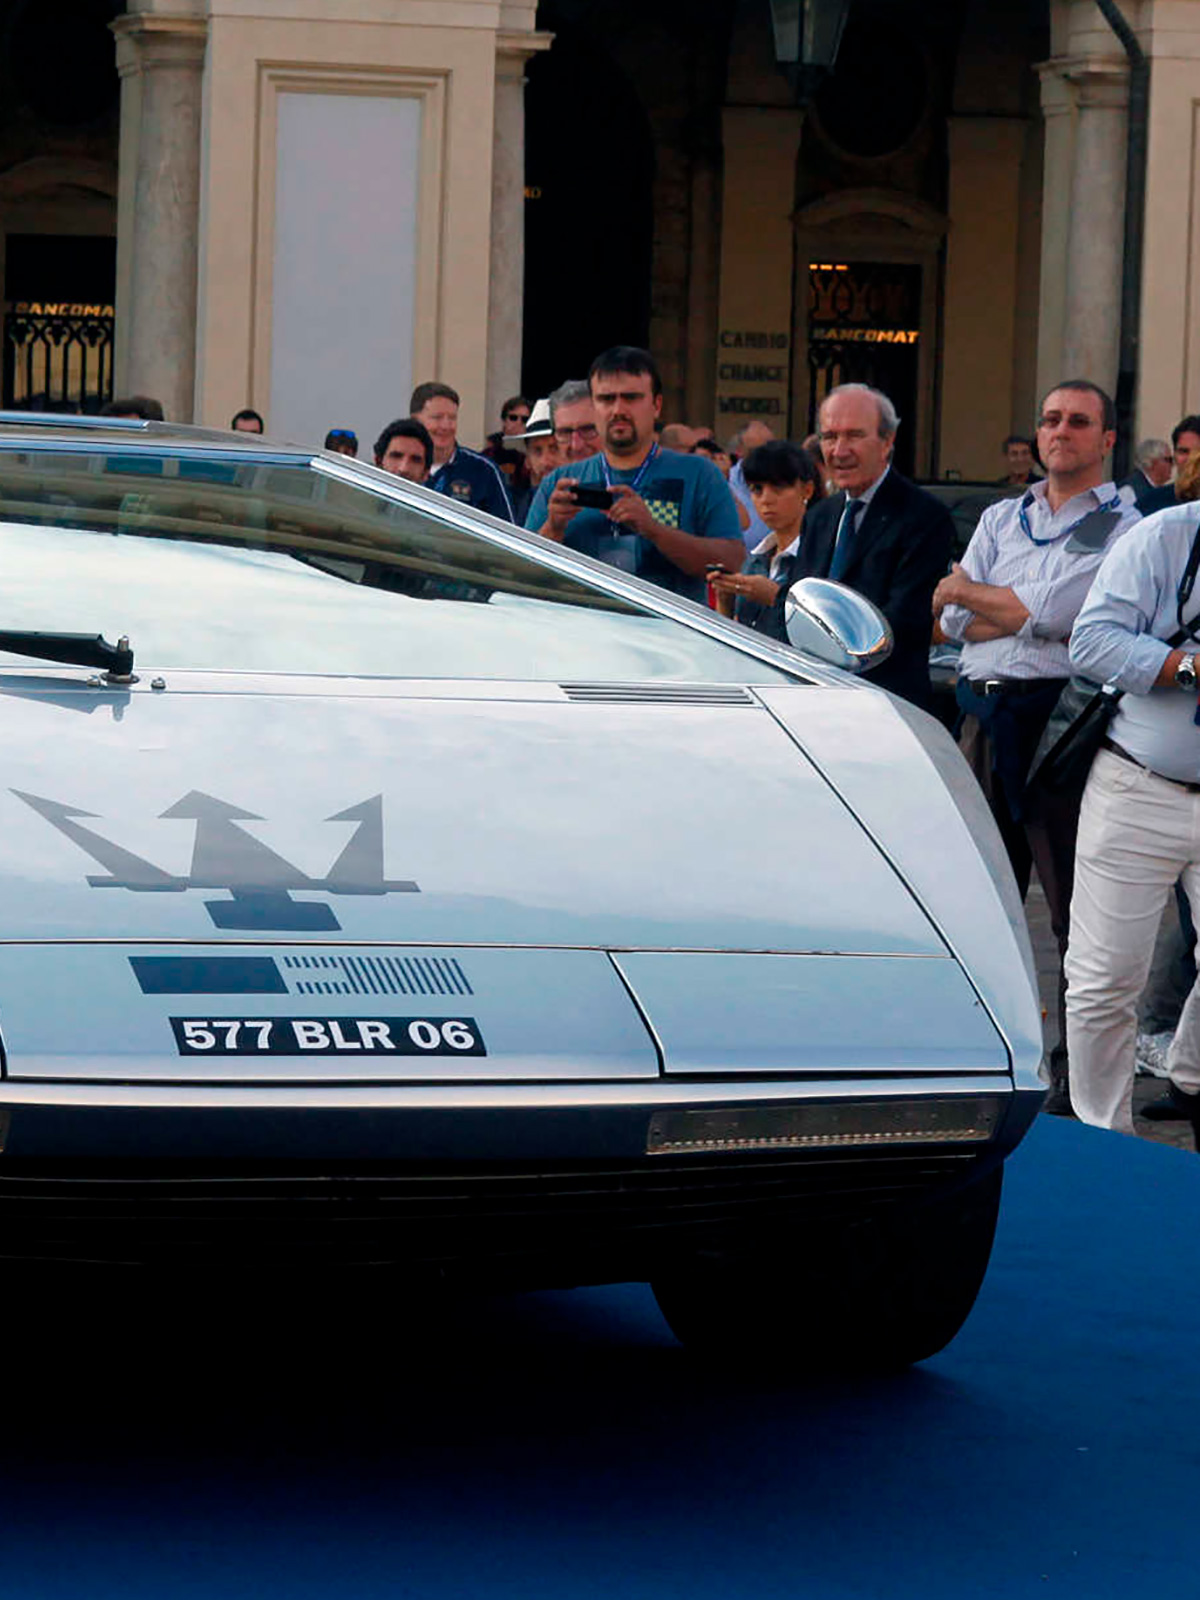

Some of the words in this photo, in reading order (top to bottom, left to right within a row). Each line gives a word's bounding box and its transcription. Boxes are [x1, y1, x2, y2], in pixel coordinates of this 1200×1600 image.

[16, 302, 115, 317] BANCOMA
[813, 327, 919, 343] BANCOMAT
[182, 1020, 273, 1050] 577
[291, 1020, 397, 1050] BLR
[407, 1020, 475, 1050] 06
